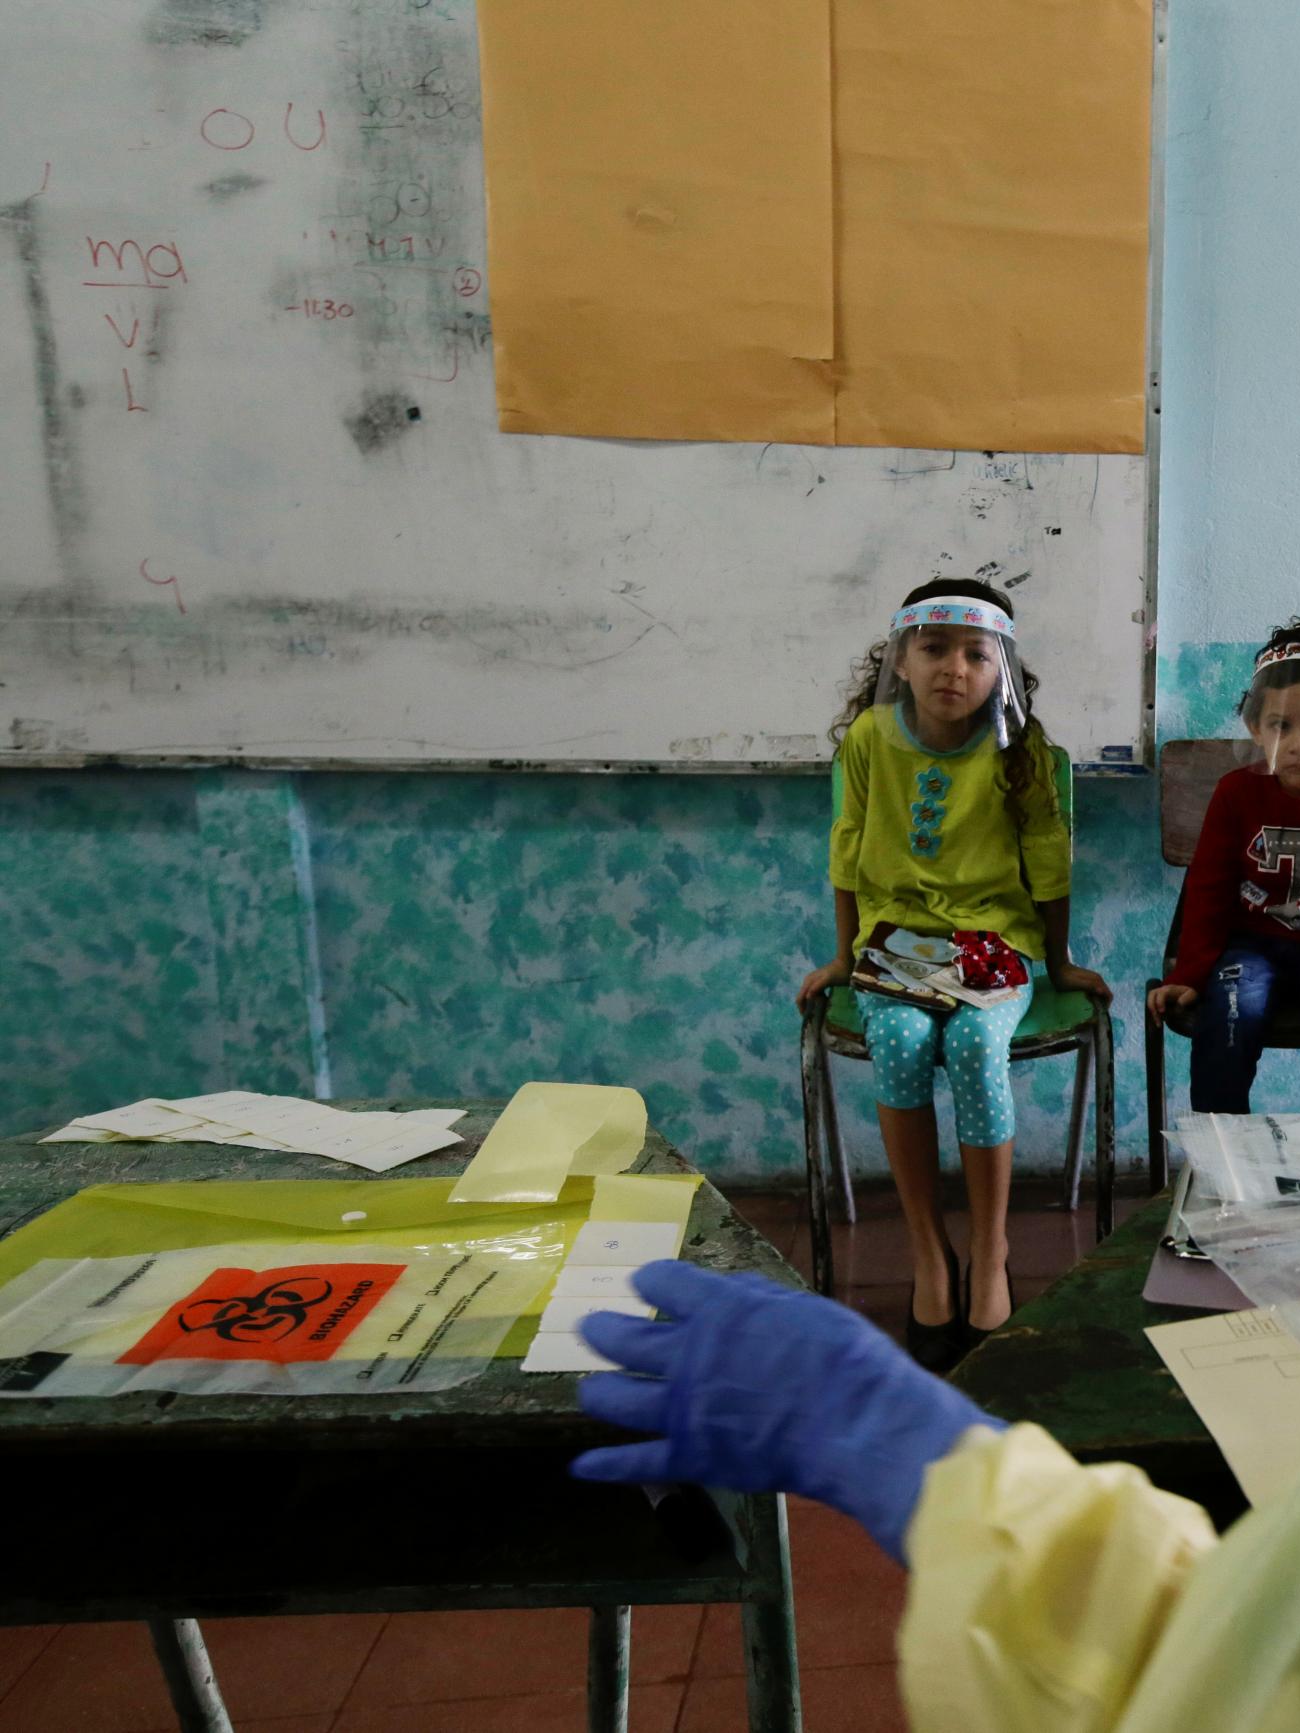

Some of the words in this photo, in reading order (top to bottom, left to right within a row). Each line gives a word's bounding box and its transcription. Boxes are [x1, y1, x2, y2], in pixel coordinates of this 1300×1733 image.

[284, 101, 326, 151] U
[86, 236, 188, 284] ma
[308, 1279, 374, 1342] BIOHAZARD
